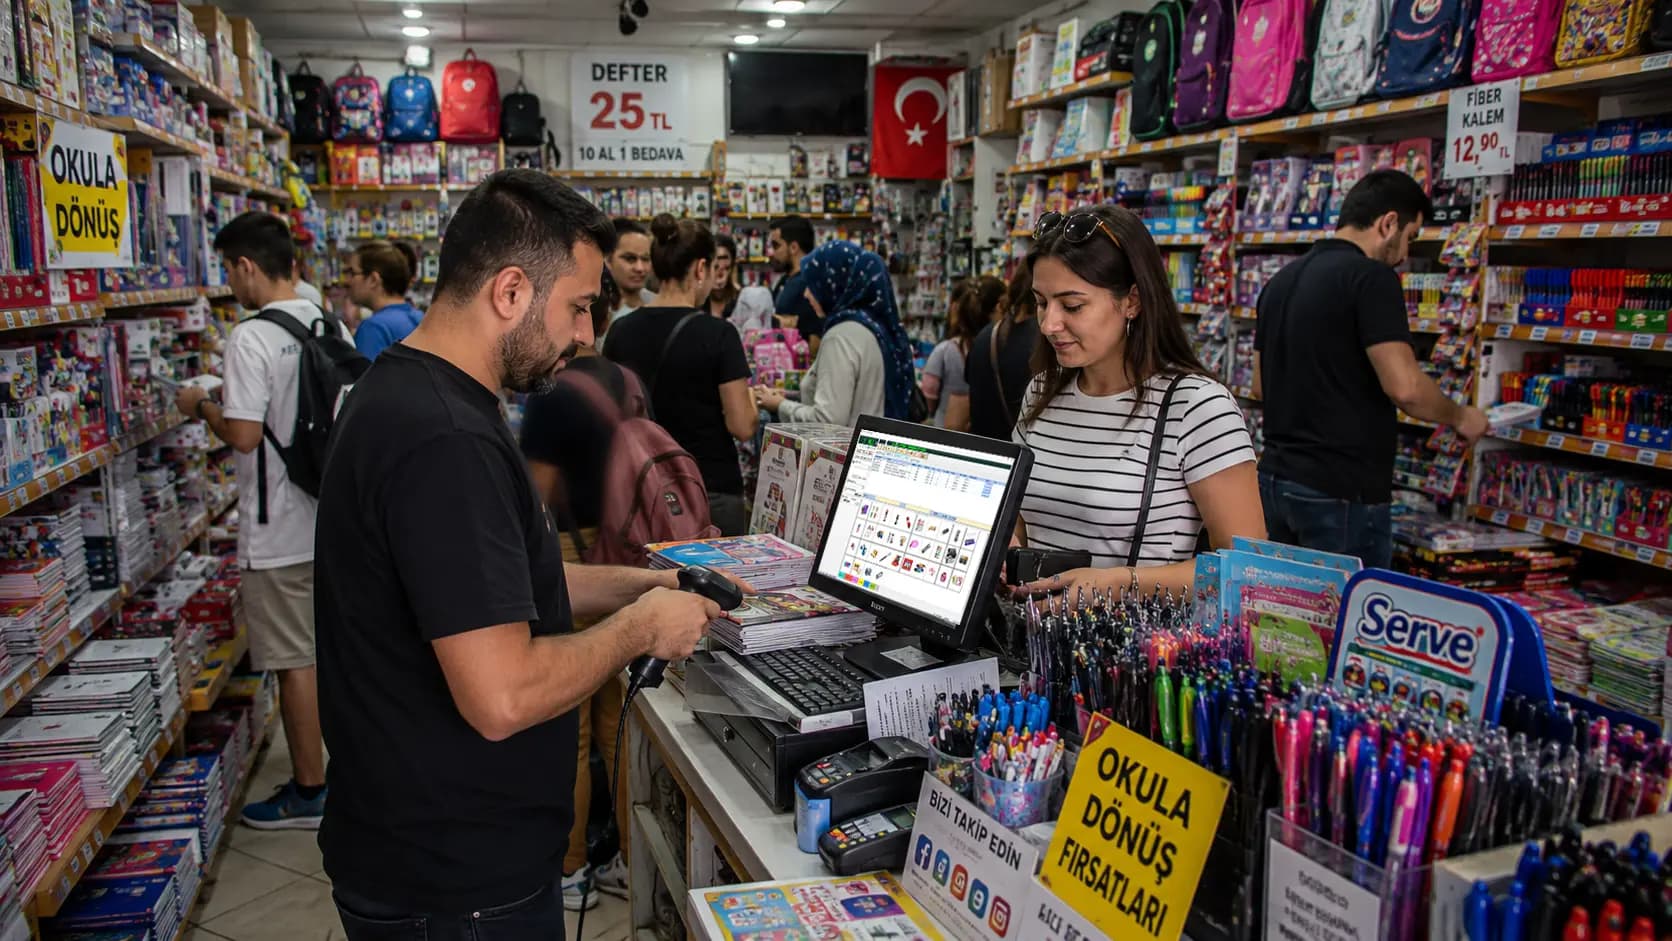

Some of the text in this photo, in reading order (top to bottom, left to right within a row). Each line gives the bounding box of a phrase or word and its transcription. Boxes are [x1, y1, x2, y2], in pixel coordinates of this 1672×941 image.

[591, 63, 668, 82] DEFTER
[589, 90, 673, 131] 25 TL
[1462, 108, 1505, 128] KALEM
[1467, 87, 1502, 106] FİBER
[50, 144, 118, 190] OKULA
[579, 146, 684, 161] 10 AL 1 BEDAVA
[1453, 132, 1511, 165] 12,90 TL
[55, 196, 120, 249] DÖNÜŞ
[1358, 594, 1478, 667] Serve
[1097, 747, 1192, 830] OKULA
[929, 789, 953, 819] BİZİ
[953, 805, 988, 843] TAKİP
[988, 832, 1022, 871] EDİN
[1081, 793, 1177, 886] DÖNÜŞ
[1057, 837, 1168, 937] FIRSATLARI
